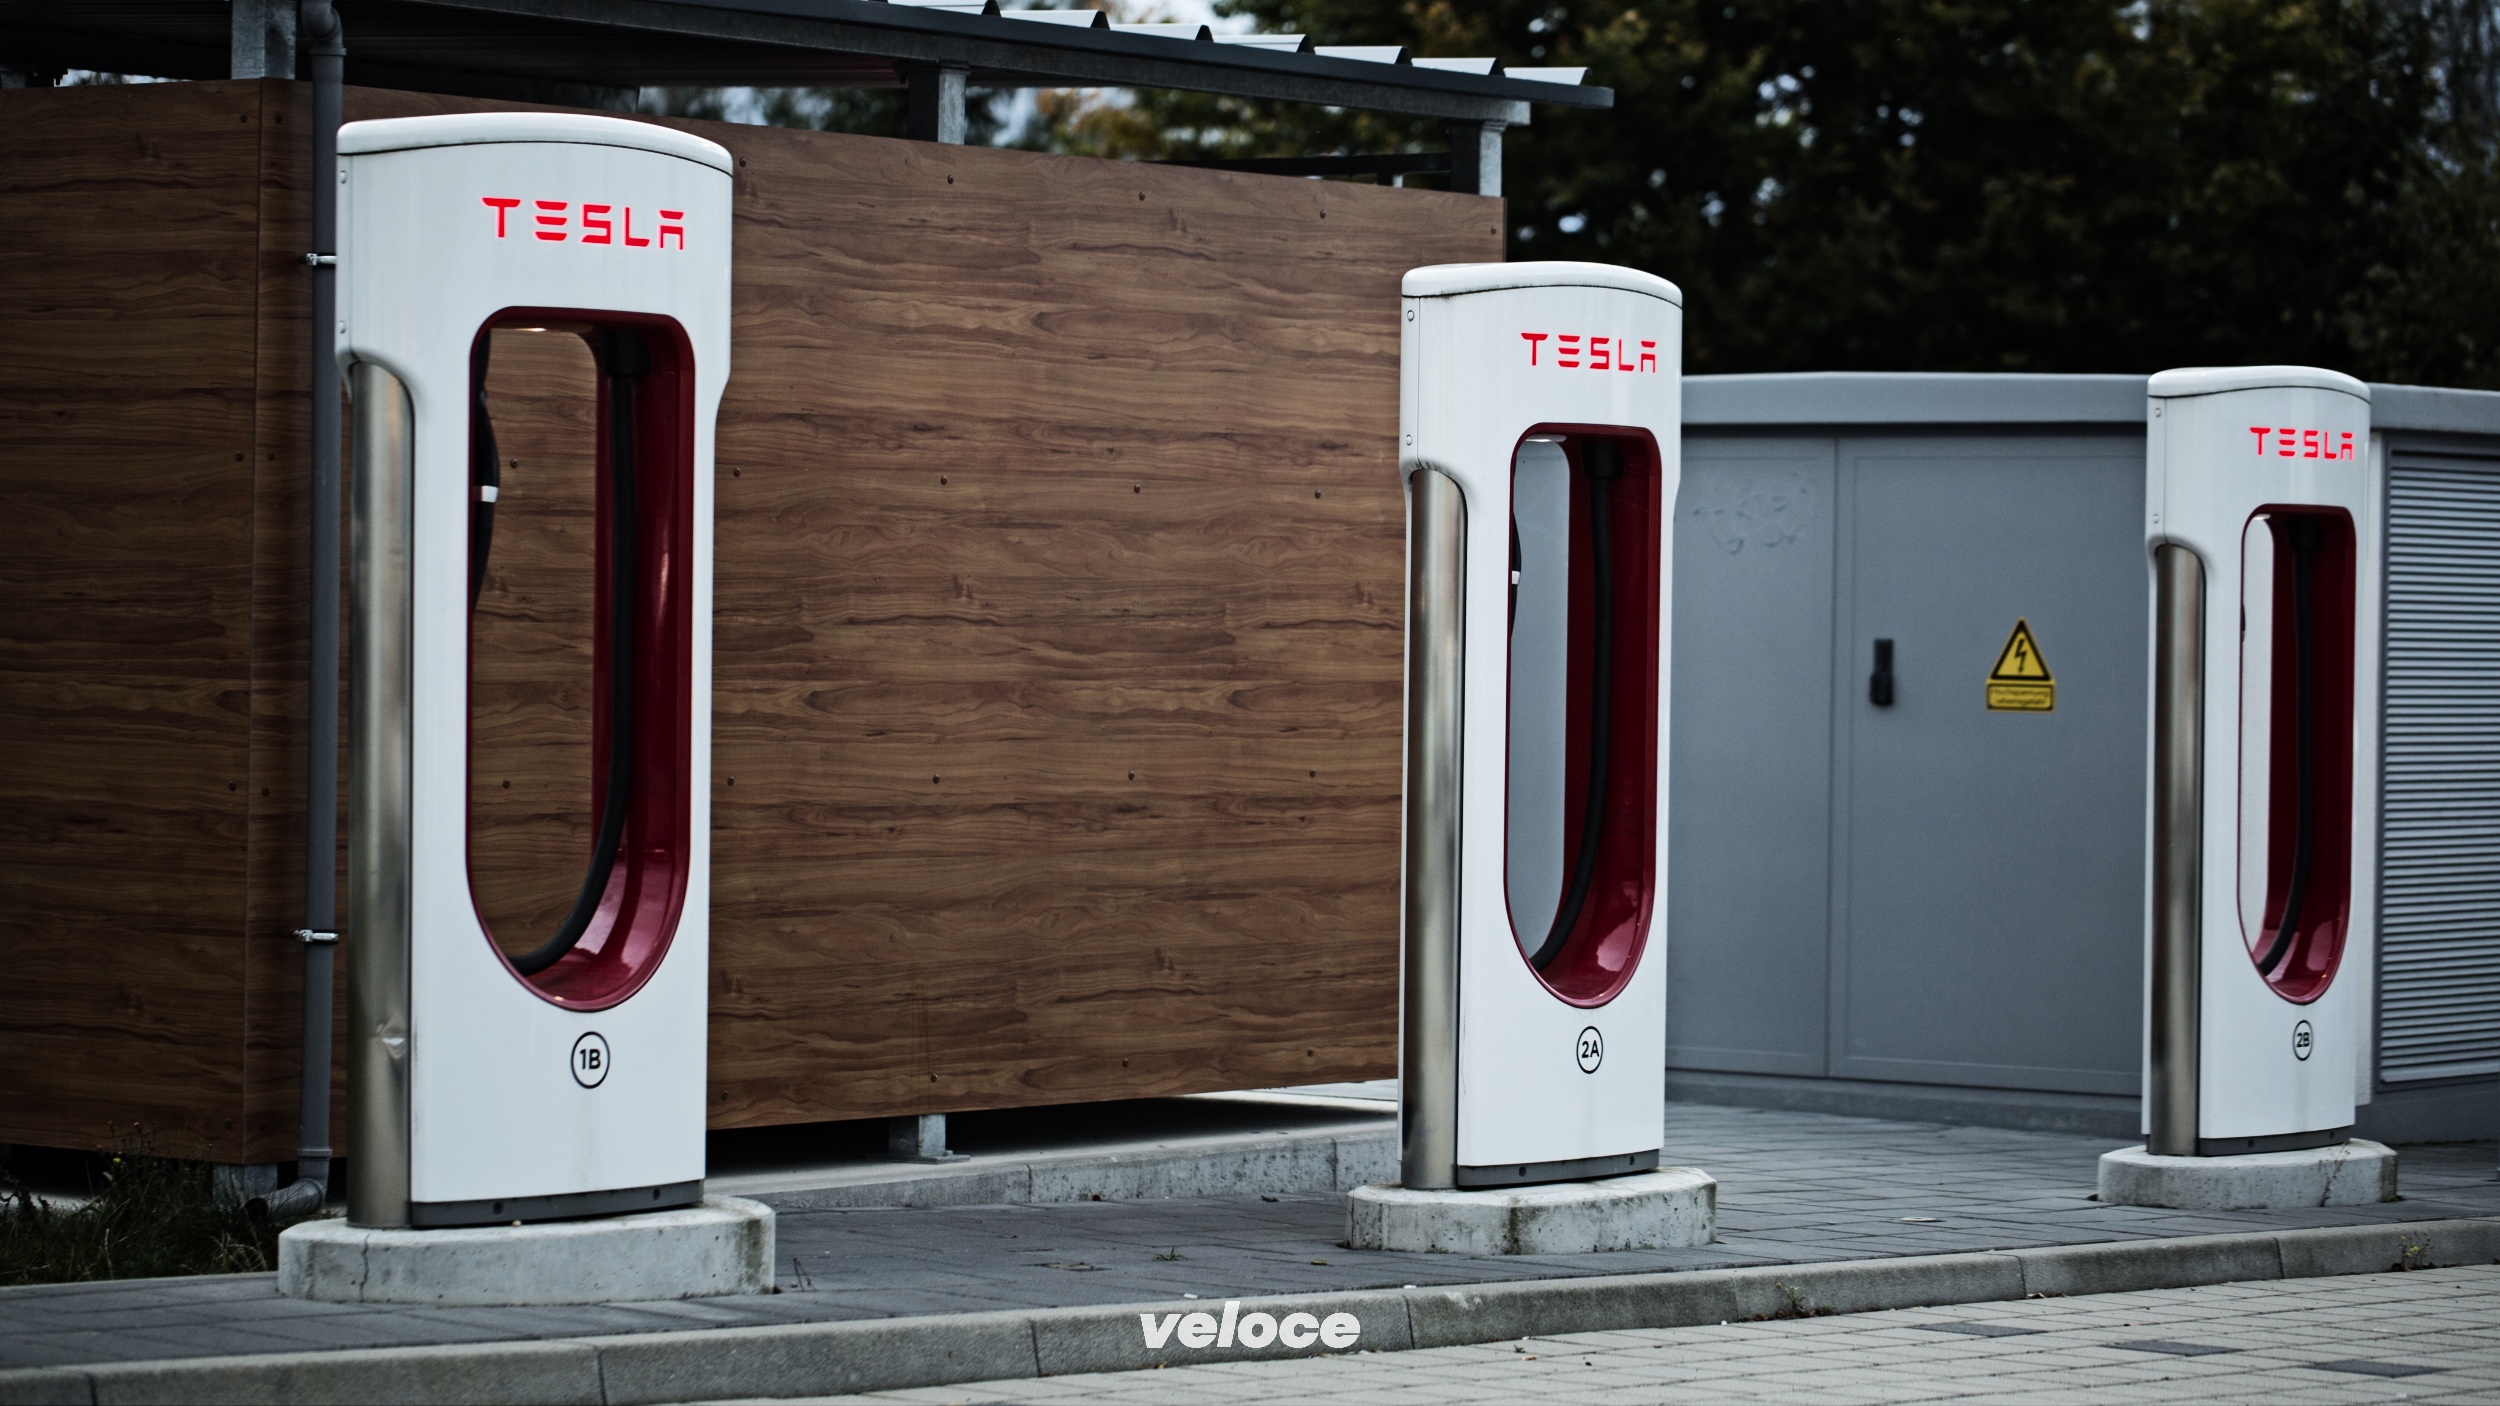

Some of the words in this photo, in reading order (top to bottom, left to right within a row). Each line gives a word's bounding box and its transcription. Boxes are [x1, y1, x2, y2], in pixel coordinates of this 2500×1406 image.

[481, 196, 685, 251] TESLA
[1520, 332, 1657, 373] TESLA
[2249, 426, 2354, 461] TESLA
[1581, 1040, 1600, 1059] 2A
[2296, 1031, 2310, 1048] 2B
[579, 1048, 601, 1070] 1B
